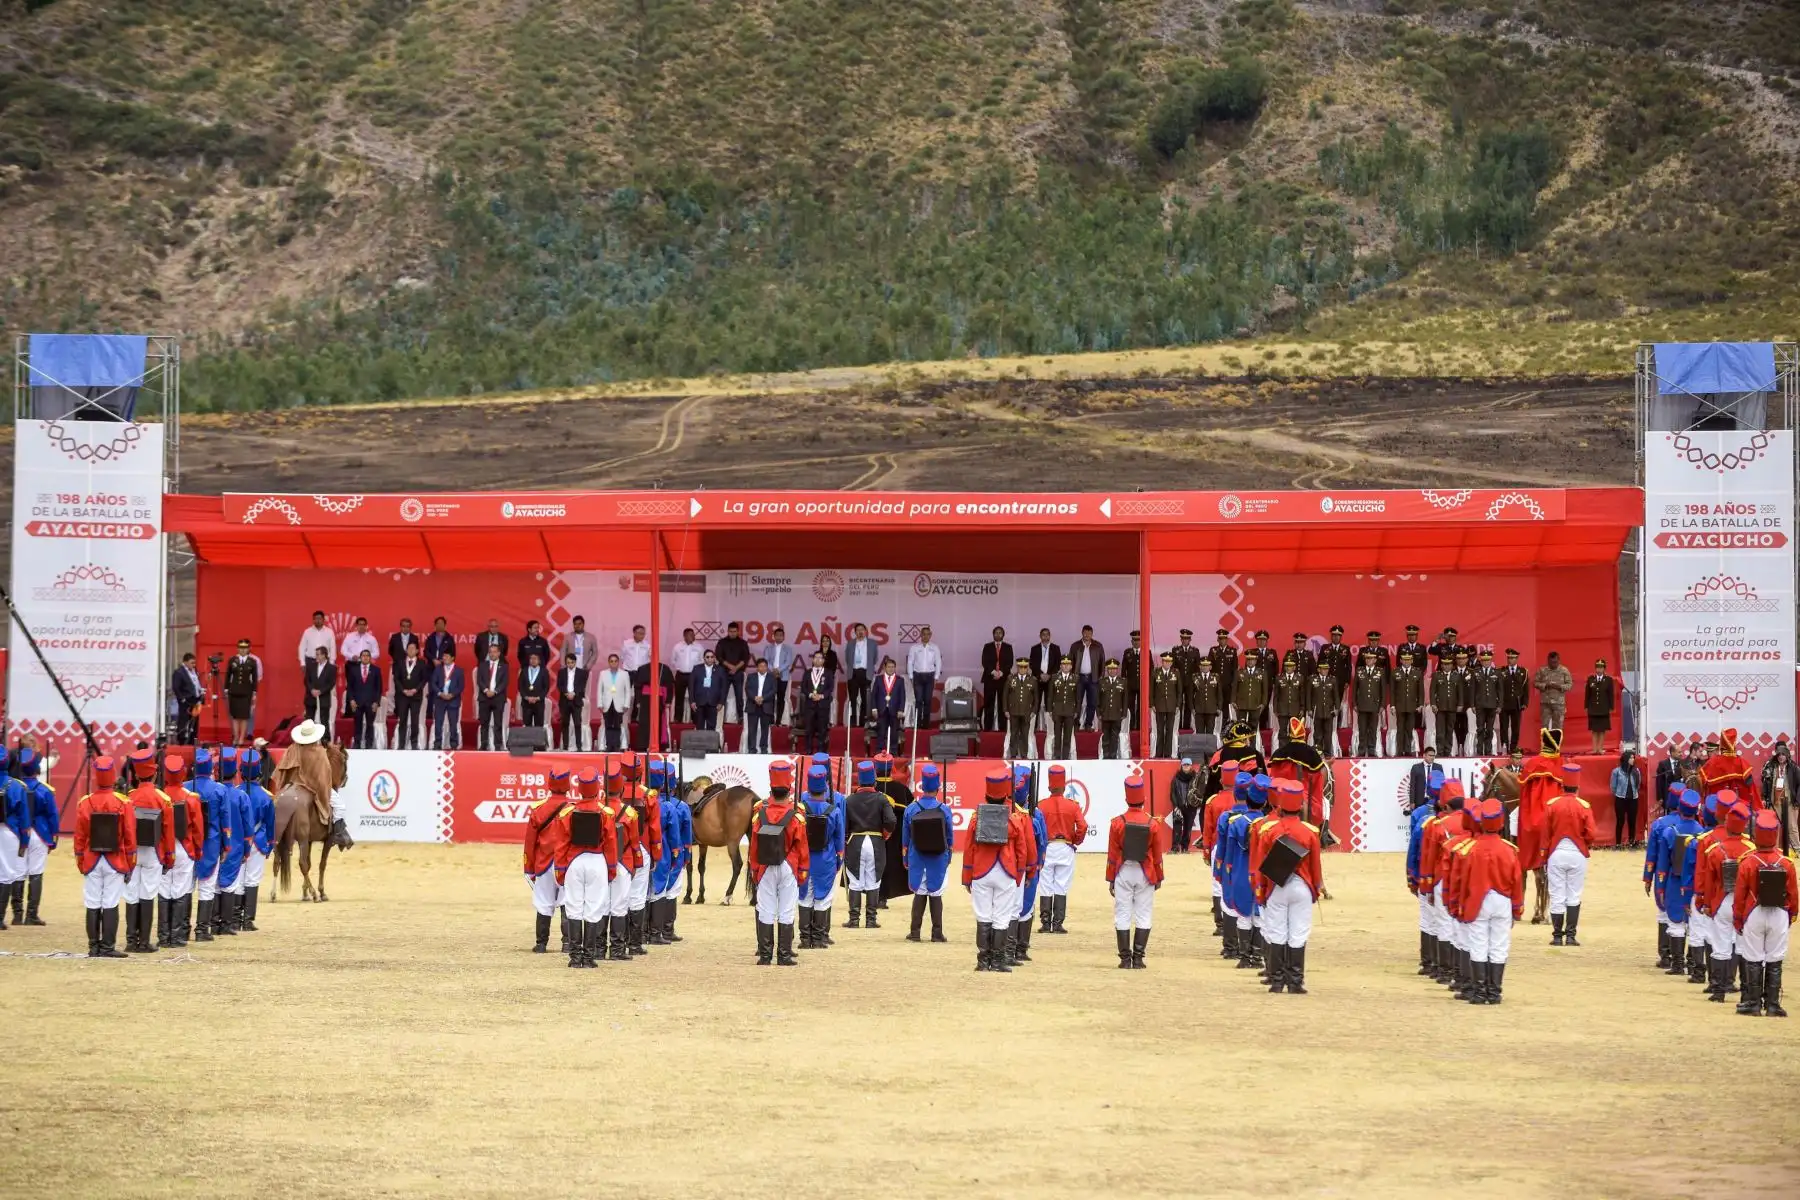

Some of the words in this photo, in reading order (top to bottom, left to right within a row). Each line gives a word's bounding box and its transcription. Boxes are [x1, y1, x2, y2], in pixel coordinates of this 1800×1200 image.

[56, 493, 80, 504] 198
[84, 492, 127, 505] AÑOS
[32, 506, 50, 516] DE
[53, 507, 69, 517] LA
[72, 508, 130, 518] BATALLA
[133, 509, 151, 518] DE
[514, 509, 565, 517] AYACUCHO
[723, 500, 743, 513] La
[749, 502, 789, 516] gran
[795, 500, 904, 516] oportunidad
[909, 502, 950, 516] para
[955, 501, 1078, 514] encontrarnos
[1334, 504, 1385, 512] AYACUCHO
[1684, 504, 1709, 515] 198
[1713, 501, 1756, 515] AÑOS
[1660, 518, 1678, 528] DE
[1682, 518, 1698, 528] LA
[1701, 518, 1760, 528] BATALLA
[1763, 518, 1781, 527] DE
[36, 523, 144, 537] AYACUCHO
[1666, 534, 1774, 546] AYACUCHO
[751, 576, 792, 586] Siempre
[765, 586, 792, 595] pueblo
[932, 585, 998, 595] AYACUCHO
[64, 613, 79, 623] La
[82, 614, 113, 625] gran
[32, 626, 111, 637] oportunidad
[114, 628, 145, 638] para
[794, 616, 889, 646] AÑOS
[1696, 625, 1711, 634] La
[1715, 626, 1745, 636] gran
[1663, 637, 1745, 648] oportunidad
[1747, 639, 1778, 648] para
[1660, 649, 1781, 660] encontrarnos
[519, 773, 545, 786] 198
[496, 788, 514, 799] DE
[517, 788, 533, 799] LA
[359, 819, 407, 827] AYACUCHO
